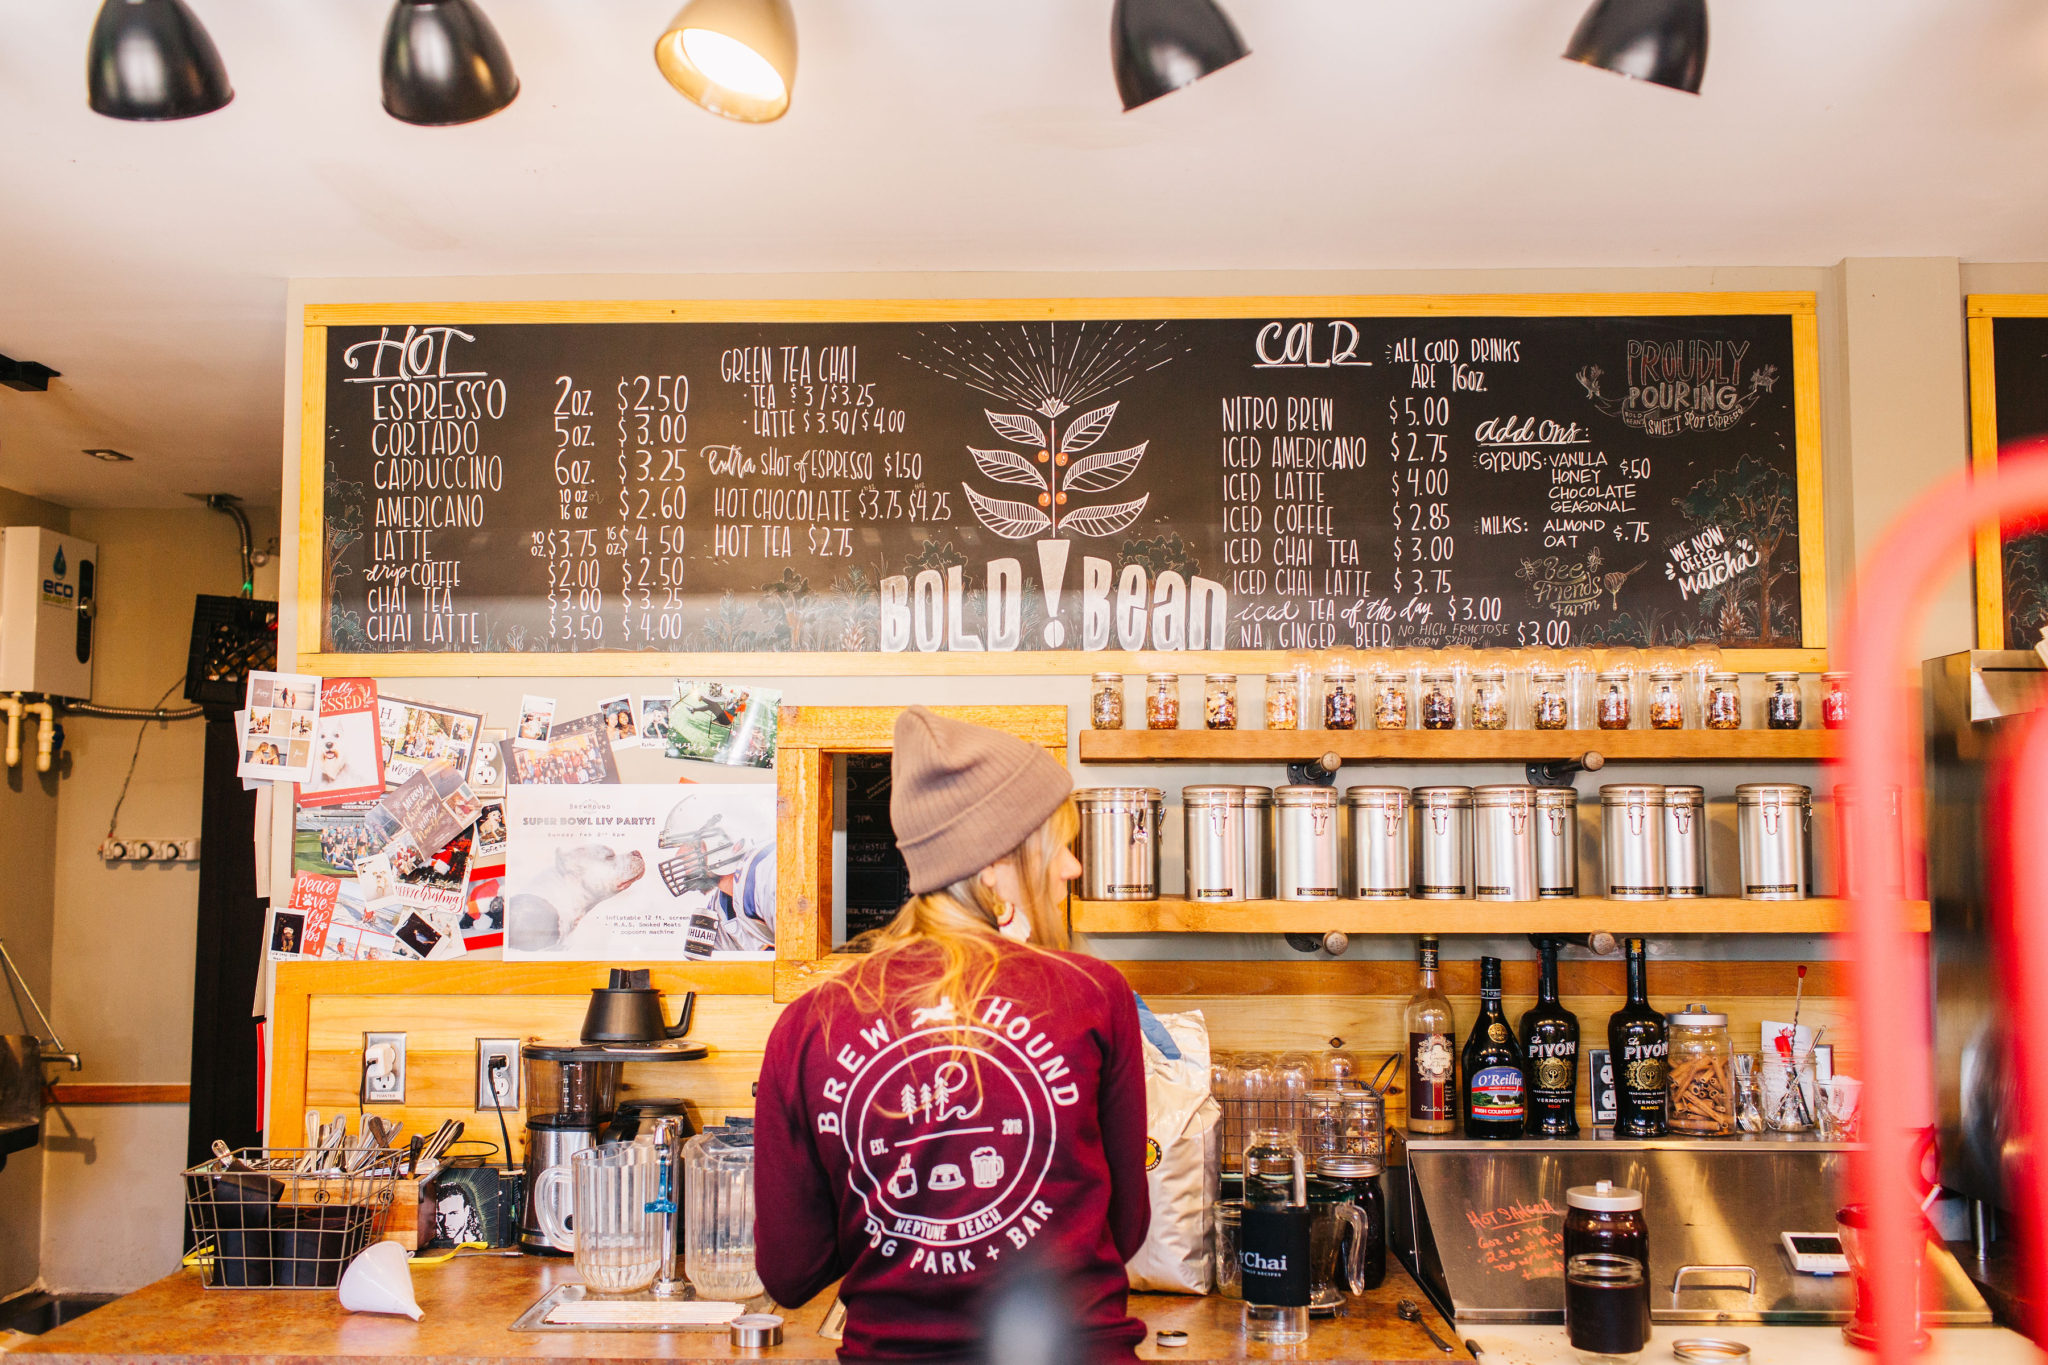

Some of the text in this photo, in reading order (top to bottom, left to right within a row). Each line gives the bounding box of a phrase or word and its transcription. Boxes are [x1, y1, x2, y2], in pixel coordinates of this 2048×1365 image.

[344, 326, 475, 380] HOT
[1256, 320, 1359, 367] COLD
[1394, 338, 1520, 363] ALL COLD DRINKS
[721, 346, 856, 386] GREEN TEA CHAI
[1412, 364, 1435, 389] ARE
[1627, 340, 1750, 387] PROUDLY
[374, 379, 507, 420] ESPRESSO
[1629, 380, 1738, 412] POURING
[754, 410, 795, 437] LATTE
[1222, 396, 1278, 432] NITRO
[1288, 397, 1333, 432] BREW
[372, 421, 478, 456] CORTADO
[1224, 436, 1261, 468] ICED
[1272, 436, 1366, 470] AMERICANO
[374, 455, 502, 491] CAPPUCCINO
[700, 444, 755, 479] extra
[794, 450, 810, 483] of
[812, 449, 872, 480] ESPRESSO
[1549, 451, 1608, 467] VANILLA
[1224, 472, 1261, 502] ICED
[1275, 472, 1325, 503] LATTE
[1548, 484, 1636, 499] CHOCOLATE
[1552, 469, 1600, 484] HONEY
[376, 494, 484, 528] AMERICANO
[559, 490, 571, 503] 10
[715, 488, 951, 522] HOT CHOCOLATE $3.75 $4.25
[1551, 501, 1636, 512] SEASONAL
[560, 505, 571, 520] 16
[1224, 505, 1262, 533] ICED
[1274, 505, 1334, 536] COFFEE
[1543, 520, 1605, 532] ALMOND
[375, 530, 432, 561] LATTE
[532, 531, 544, 544] 10
[606, 527, 616, 540] 16
[715, 524, 853, 557] HOT TEA $2.75
[1544, 535, 1577, 548] OAT
[1670, 541, 1690, 562] WE
[1692, 526, 1725, 554] NOW
[1224, 540, 1261, 564] ICED
[1273, 536, 1312, 566] CHAI
[1327, 539, 1359, 568] TEA
[1680, 548, 1722, 573] OFFER
[363, 565, 410, 589] drip
[411, 561, 461, 587] COFFEE
[1233, 570, 1266, 595] ICED
[1275, 569, 1312, 597] CHAI
[1326, 570, 1371, 597] LATTE
[1544, 556, 1585, 580] Bee
[368, 586, 407, 614] CHAI
[423, 586, 452, 613] TEA
[881, 558, 1022, 651] BOLD
[1236, 601, 1299, 621] iced
[1309, 599, 1334, 622] TEA
[1341, 600, 1366, 628] of
[1366, 598, 1396, 621] the
[1400, 598, 1433, 624] day
[366, 614, 411, 642] CHAI
[423, 612, 479, 644] LATTE
[1241, 623, 1391, 649] NA GINGER BEER
[1518, 620, 1570, 646] $3.00
[320, 695, 362, 713] ESSED
[595, 817, 614, 825] LIV
[817, 997, 1079, 1136] BREW HOUND
[894, 1207, 1003, 1241] NEPTUNE BEACH
[910, 1248, 976, 1274] PARK
[1006, 1200, 1053, 1249] BAR
